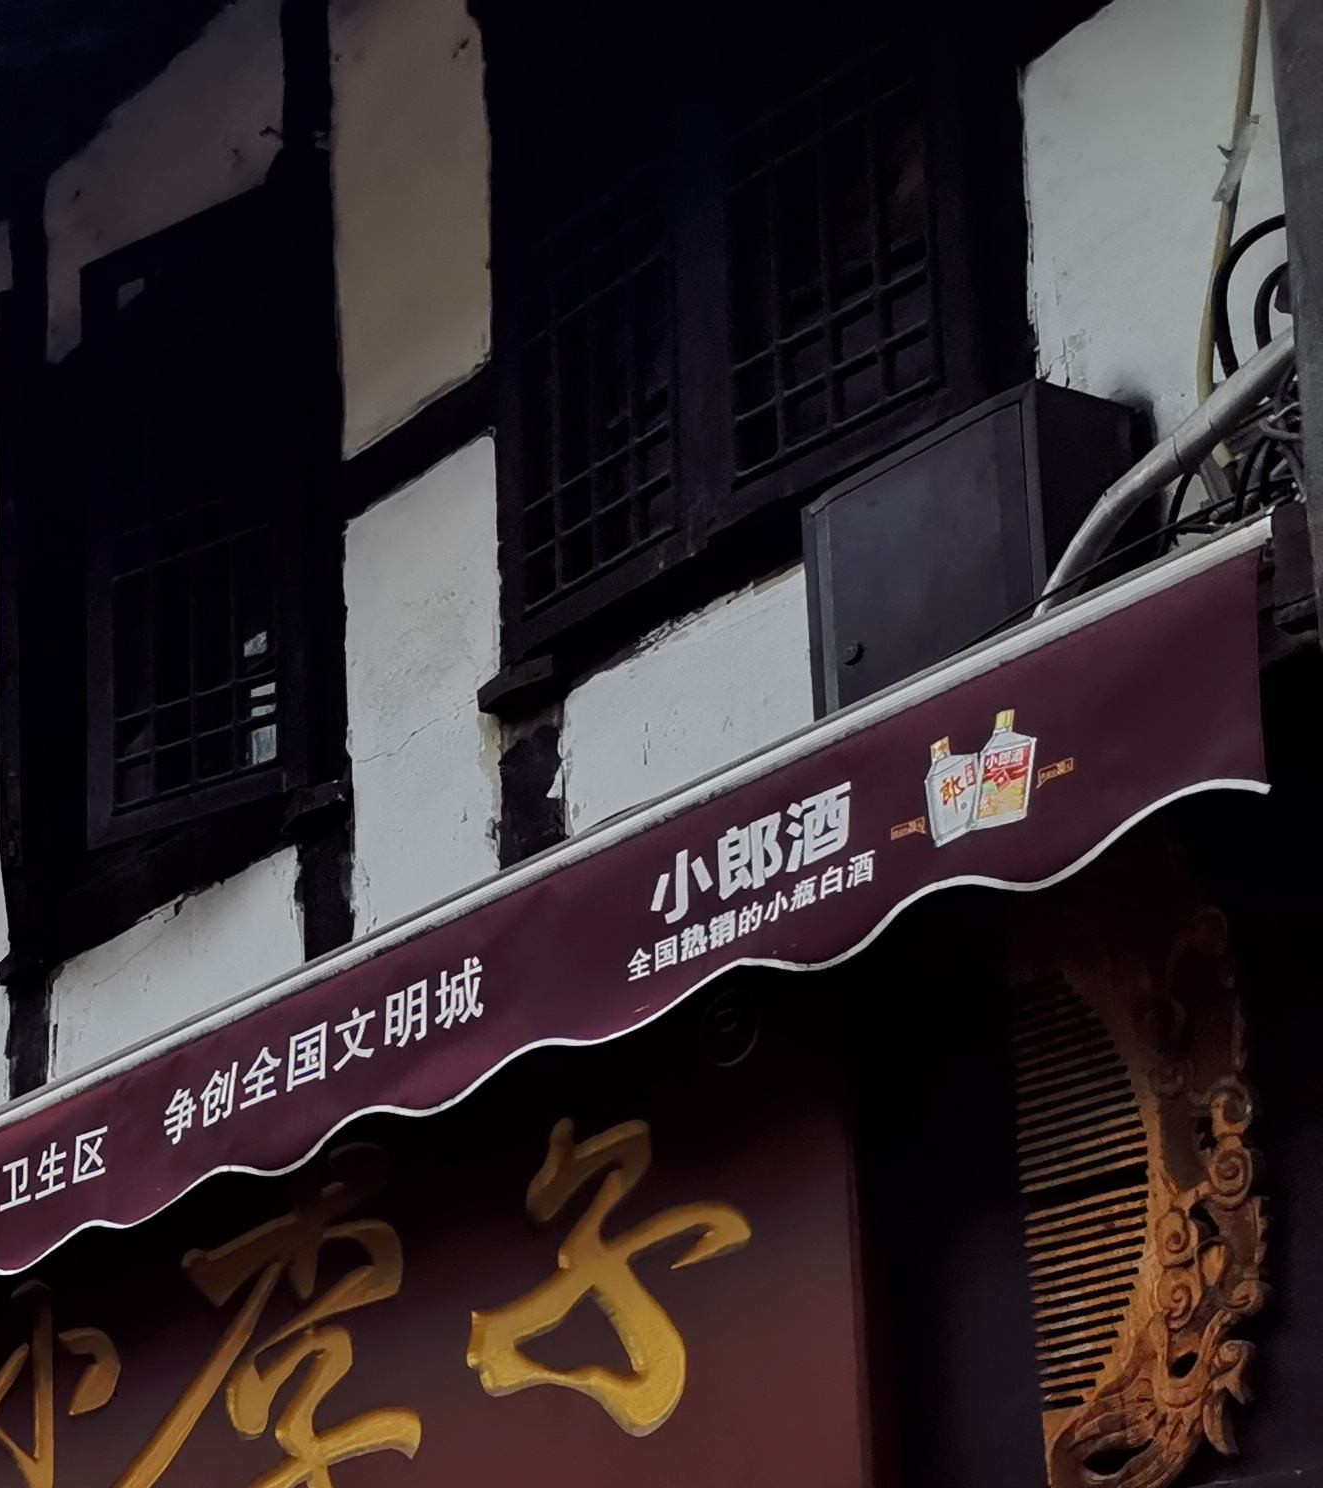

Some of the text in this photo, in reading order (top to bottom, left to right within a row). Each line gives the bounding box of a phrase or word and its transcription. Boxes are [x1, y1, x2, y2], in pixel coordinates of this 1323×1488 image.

[626, 850, 875, 983] 全国热销的小瓶白酒
[649, 781, 853, 925] 小郎酒
[163, 956, 484, 1145] 争创全国文明城
